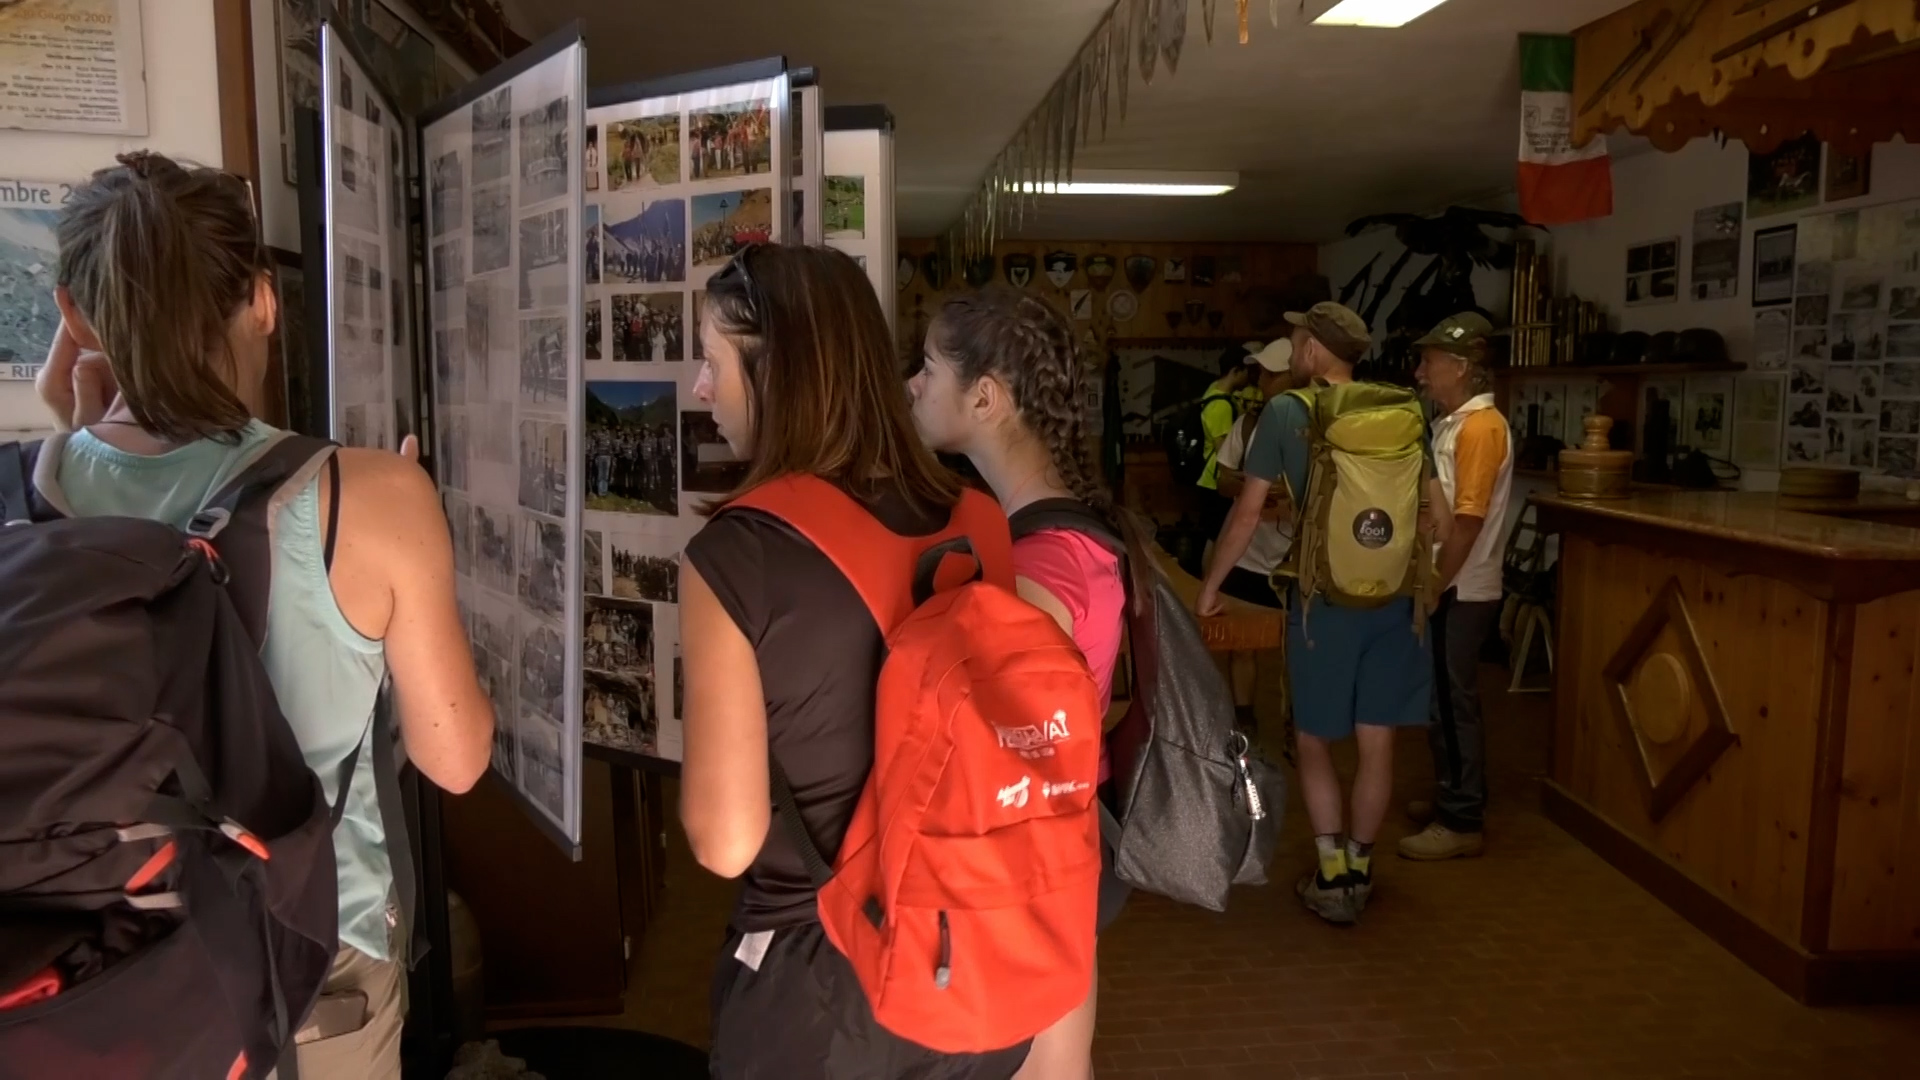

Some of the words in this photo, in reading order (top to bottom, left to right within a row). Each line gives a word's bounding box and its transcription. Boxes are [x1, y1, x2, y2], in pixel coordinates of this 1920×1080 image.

[38, 9, 81, 23] Giugno
[84, 11, 112, 24] 2007
[64, 25, 112, 36] Programma
